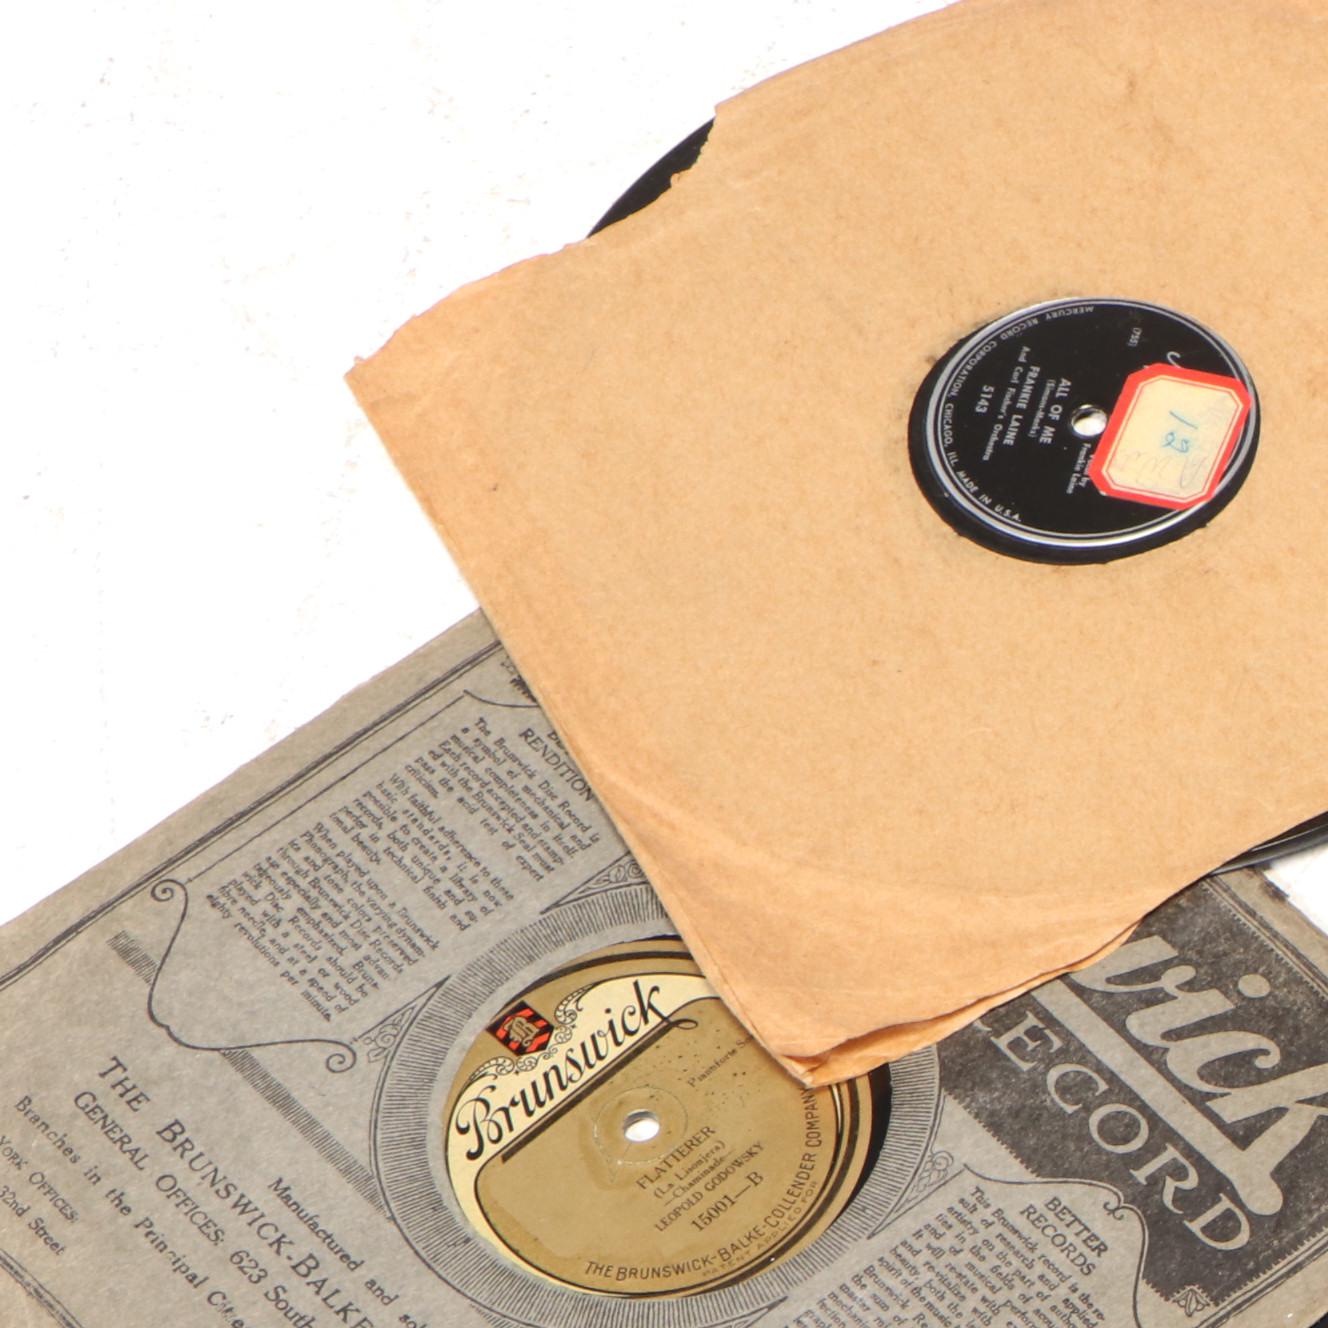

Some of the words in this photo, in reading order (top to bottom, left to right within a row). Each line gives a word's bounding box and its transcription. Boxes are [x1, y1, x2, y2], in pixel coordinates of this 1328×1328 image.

[1000, 318, 1039, 340] RECORD
[1045, 306, 1094, 320] MERCURY
[975, 385, 994, 413] 5143
[1016, 365, 1040, 409] FRANKIE
[1047, 404, 1063, 421] OF
[1055, 378, 1072, 398] ALL
[1003, 414, 1023, 446] LAINE
[1039, 426, 1056, 444] ME
[956, 471, 979, 493] MADE
[994, 505, 1022, 522] U.S.A.
[518, 727, 596, 802] RENDITION
[98, 1056, 151, 1113] THE
[455, 979, 698, 1161] Brunswick
[14, 1095, 81, 1165] Branches
[83, 1166, 102, 1186] in
[105, 1188, 132, 1217] the
[635, 1125, 716, 1190] FLATTERER
[970, 1009, 1251, 1252] ECORD
[73, 1091, 151, 1171] GENERAL
[155, 1173, 225, 1246] OFFICES:
[229, 1250, 268, 1285] 623
[584, 1260, 614, 1279] THE
[615, 1152, 816, 1281] BRUNSWICK-BALKE-COLLENDER
[802, 1086, 822, 1148] COMPANY
[655, 1191, 704, 1232] LEOPOLD
[704, 1141, 764, 1192] GODOWSKY
[28, 1217, 66, 1256] Street
[266, 1176, 365, 1272] Manufactured
[364, 1279, 400, 1306] and
[1019, 1203, 1096, 1276] RECORDS
[1044, 1196, 1109, 1258] BETTER
